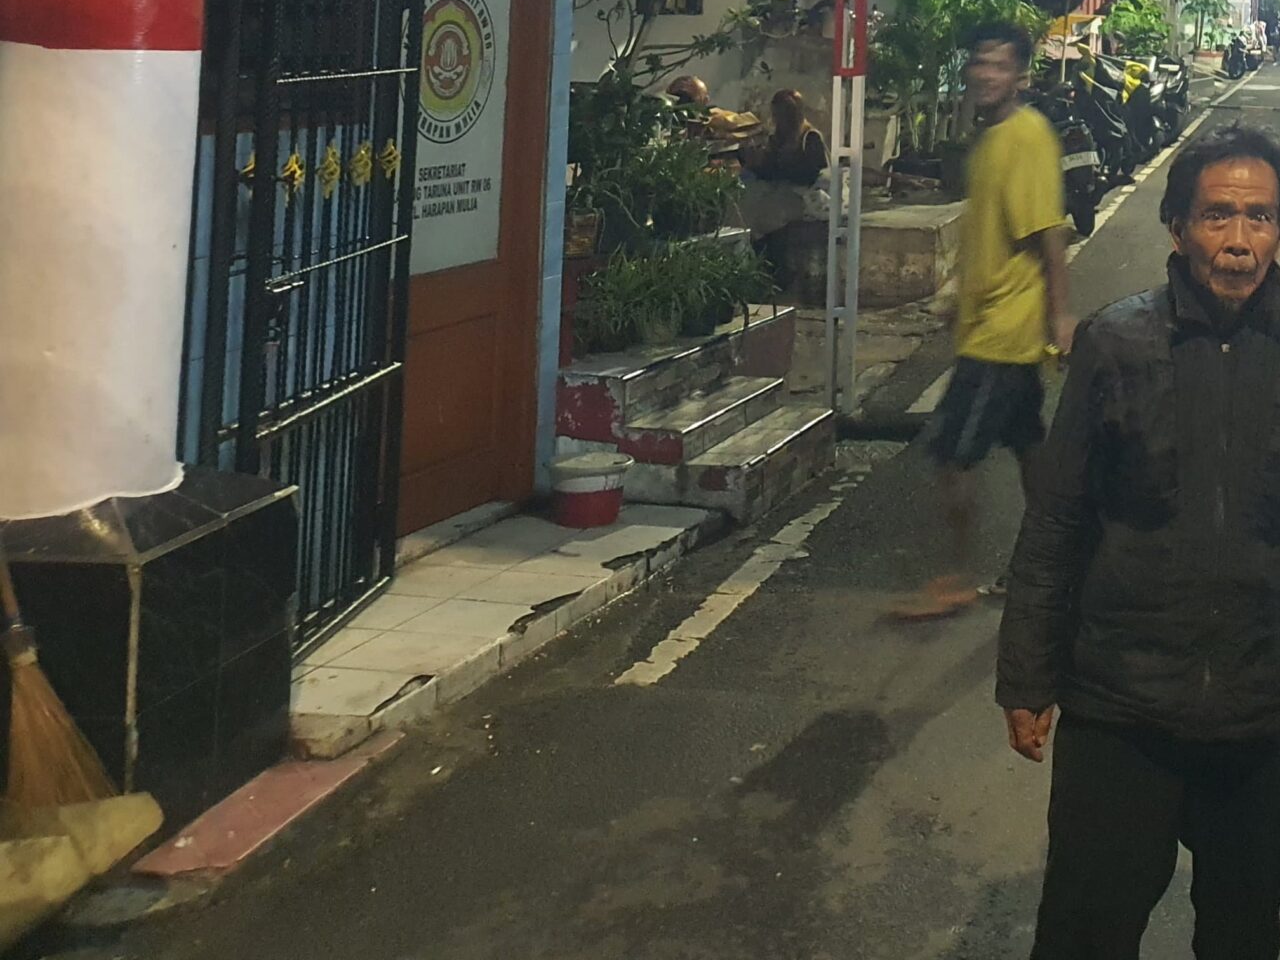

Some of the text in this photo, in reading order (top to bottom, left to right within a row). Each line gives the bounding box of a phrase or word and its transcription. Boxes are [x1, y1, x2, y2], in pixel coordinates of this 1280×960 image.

[454, 100, 481, 135] MULIA
[418, 163, 466, 182] SEKRETARIAT
[424, 183, 452, 200] TARUNA
[453, 180, 470, 196] UNIT
[422, 201, 455, 218] HARAPAN
[456, 197, 478, 214] MULIA
